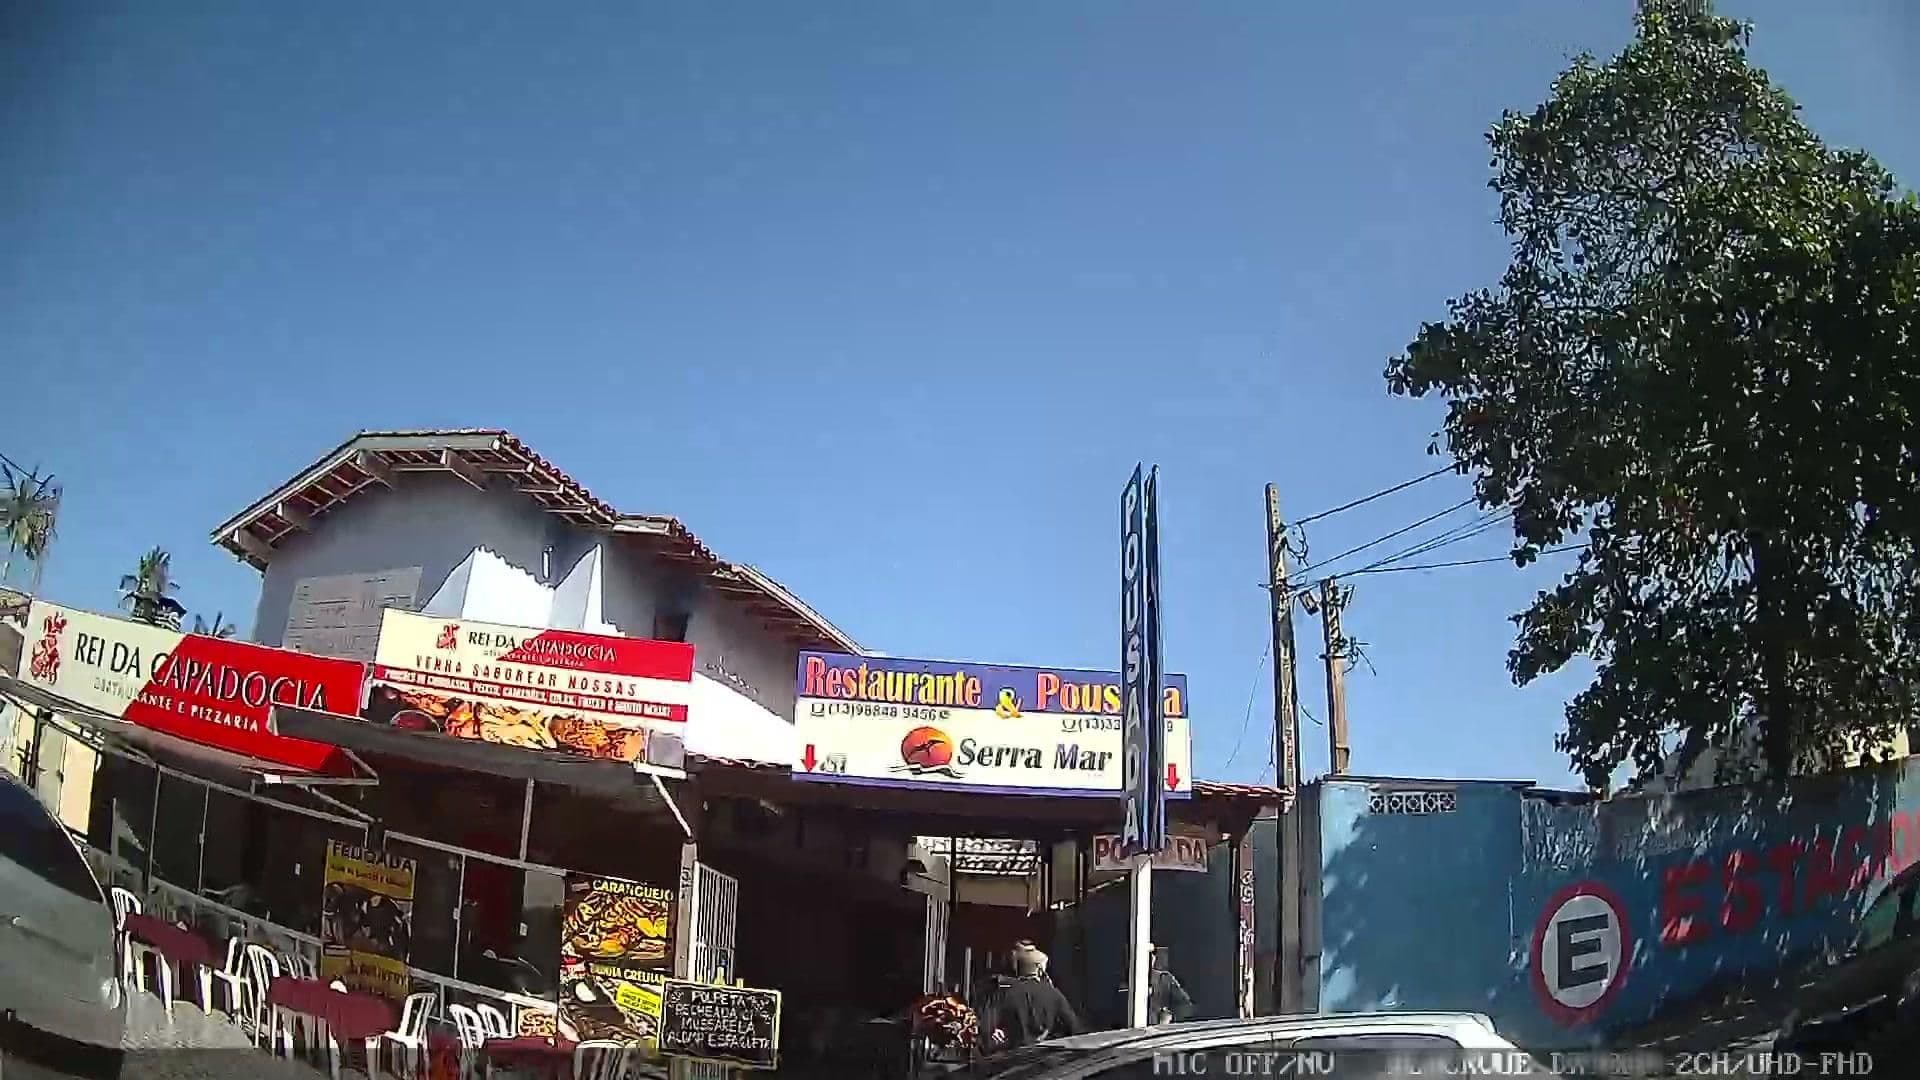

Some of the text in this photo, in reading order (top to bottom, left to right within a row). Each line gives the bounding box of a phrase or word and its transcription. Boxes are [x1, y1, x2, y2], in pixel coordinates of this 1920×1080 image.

[468, 631, 489, 647] REI
[495, 633, 516, 649] DA
[520, 638, 617, 662] CAPADOCIA
[1124, 482, 1143, 846] POUSADA
[75, 632, 327, 711] REI DA CAPADOCIA
[472, 663, 557, 687] SABOREAR
[568, 671, 637, 697] NOSSAS
[805, 656, 1182, 720] Restaurante & Pousa
[178, 701, 185, 714] E
[191, 704, 259, 733] PIZZARIA
[957, 738, 1112, 772] Serra Mar
[1556, 913, 1609, 990] E
